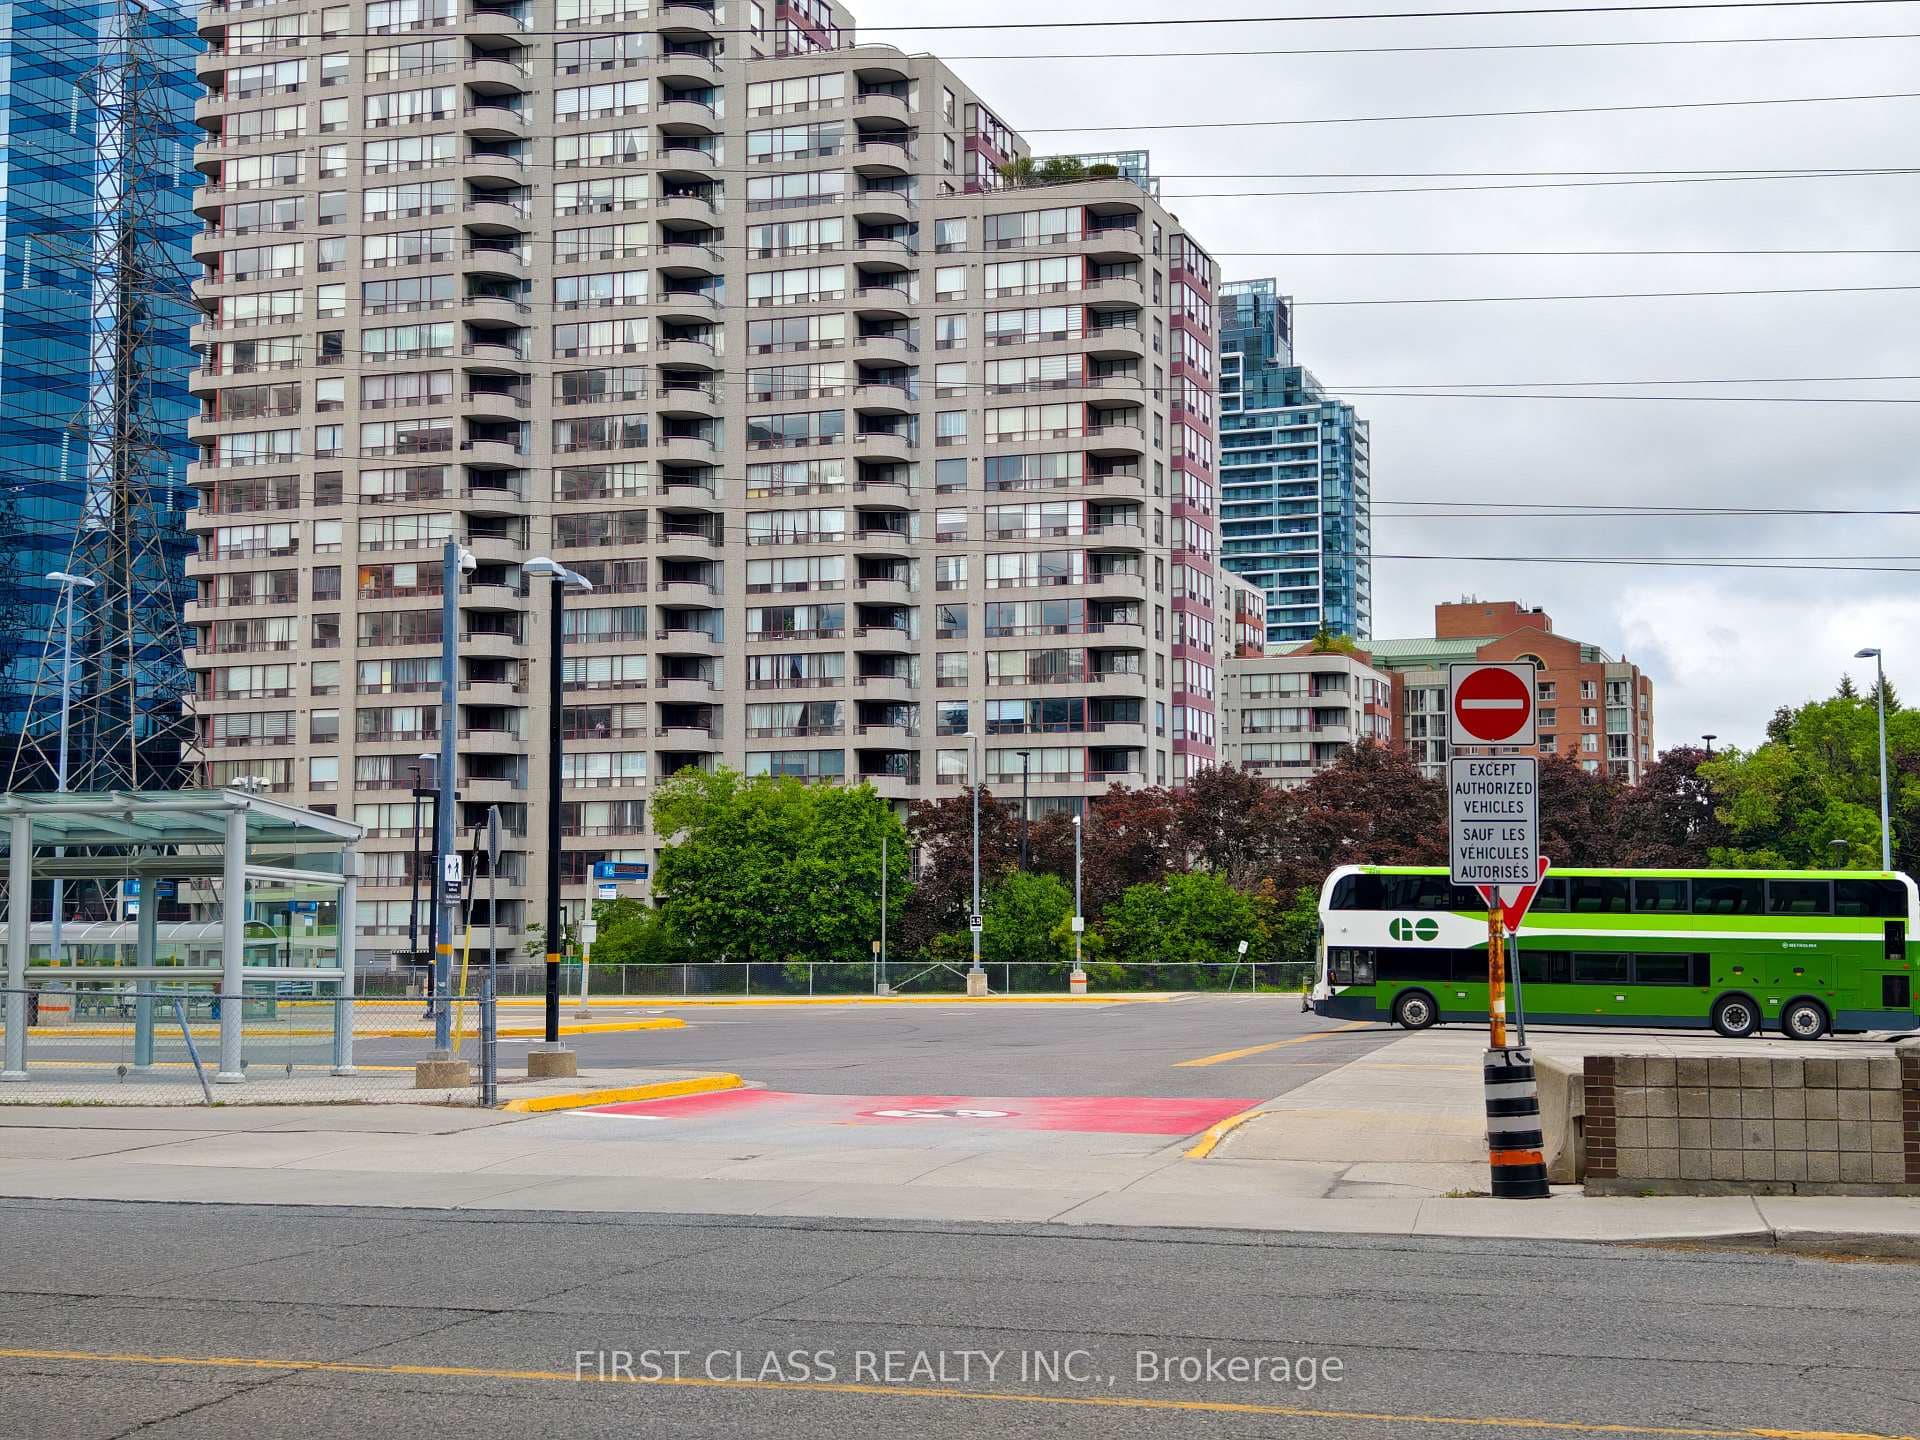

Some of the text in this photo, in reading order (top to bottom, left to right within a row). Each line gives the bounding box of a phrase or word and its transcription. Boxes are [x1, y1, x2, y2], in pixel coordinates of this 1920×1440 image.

[1470, 763, 1517, 776] EXCEPT
[1455, 782, 1533, 795] AUTHORIZED
[1464, 800, 1524, 814] VEHICLES
[1463, 828, 1525, 841] SAUF LES
[1460, 843, 1529, 860] VÉHICULES
[1461, 861, 1529, 879] AUTORISÉS
[1389, 917, 1439, 942] GO
